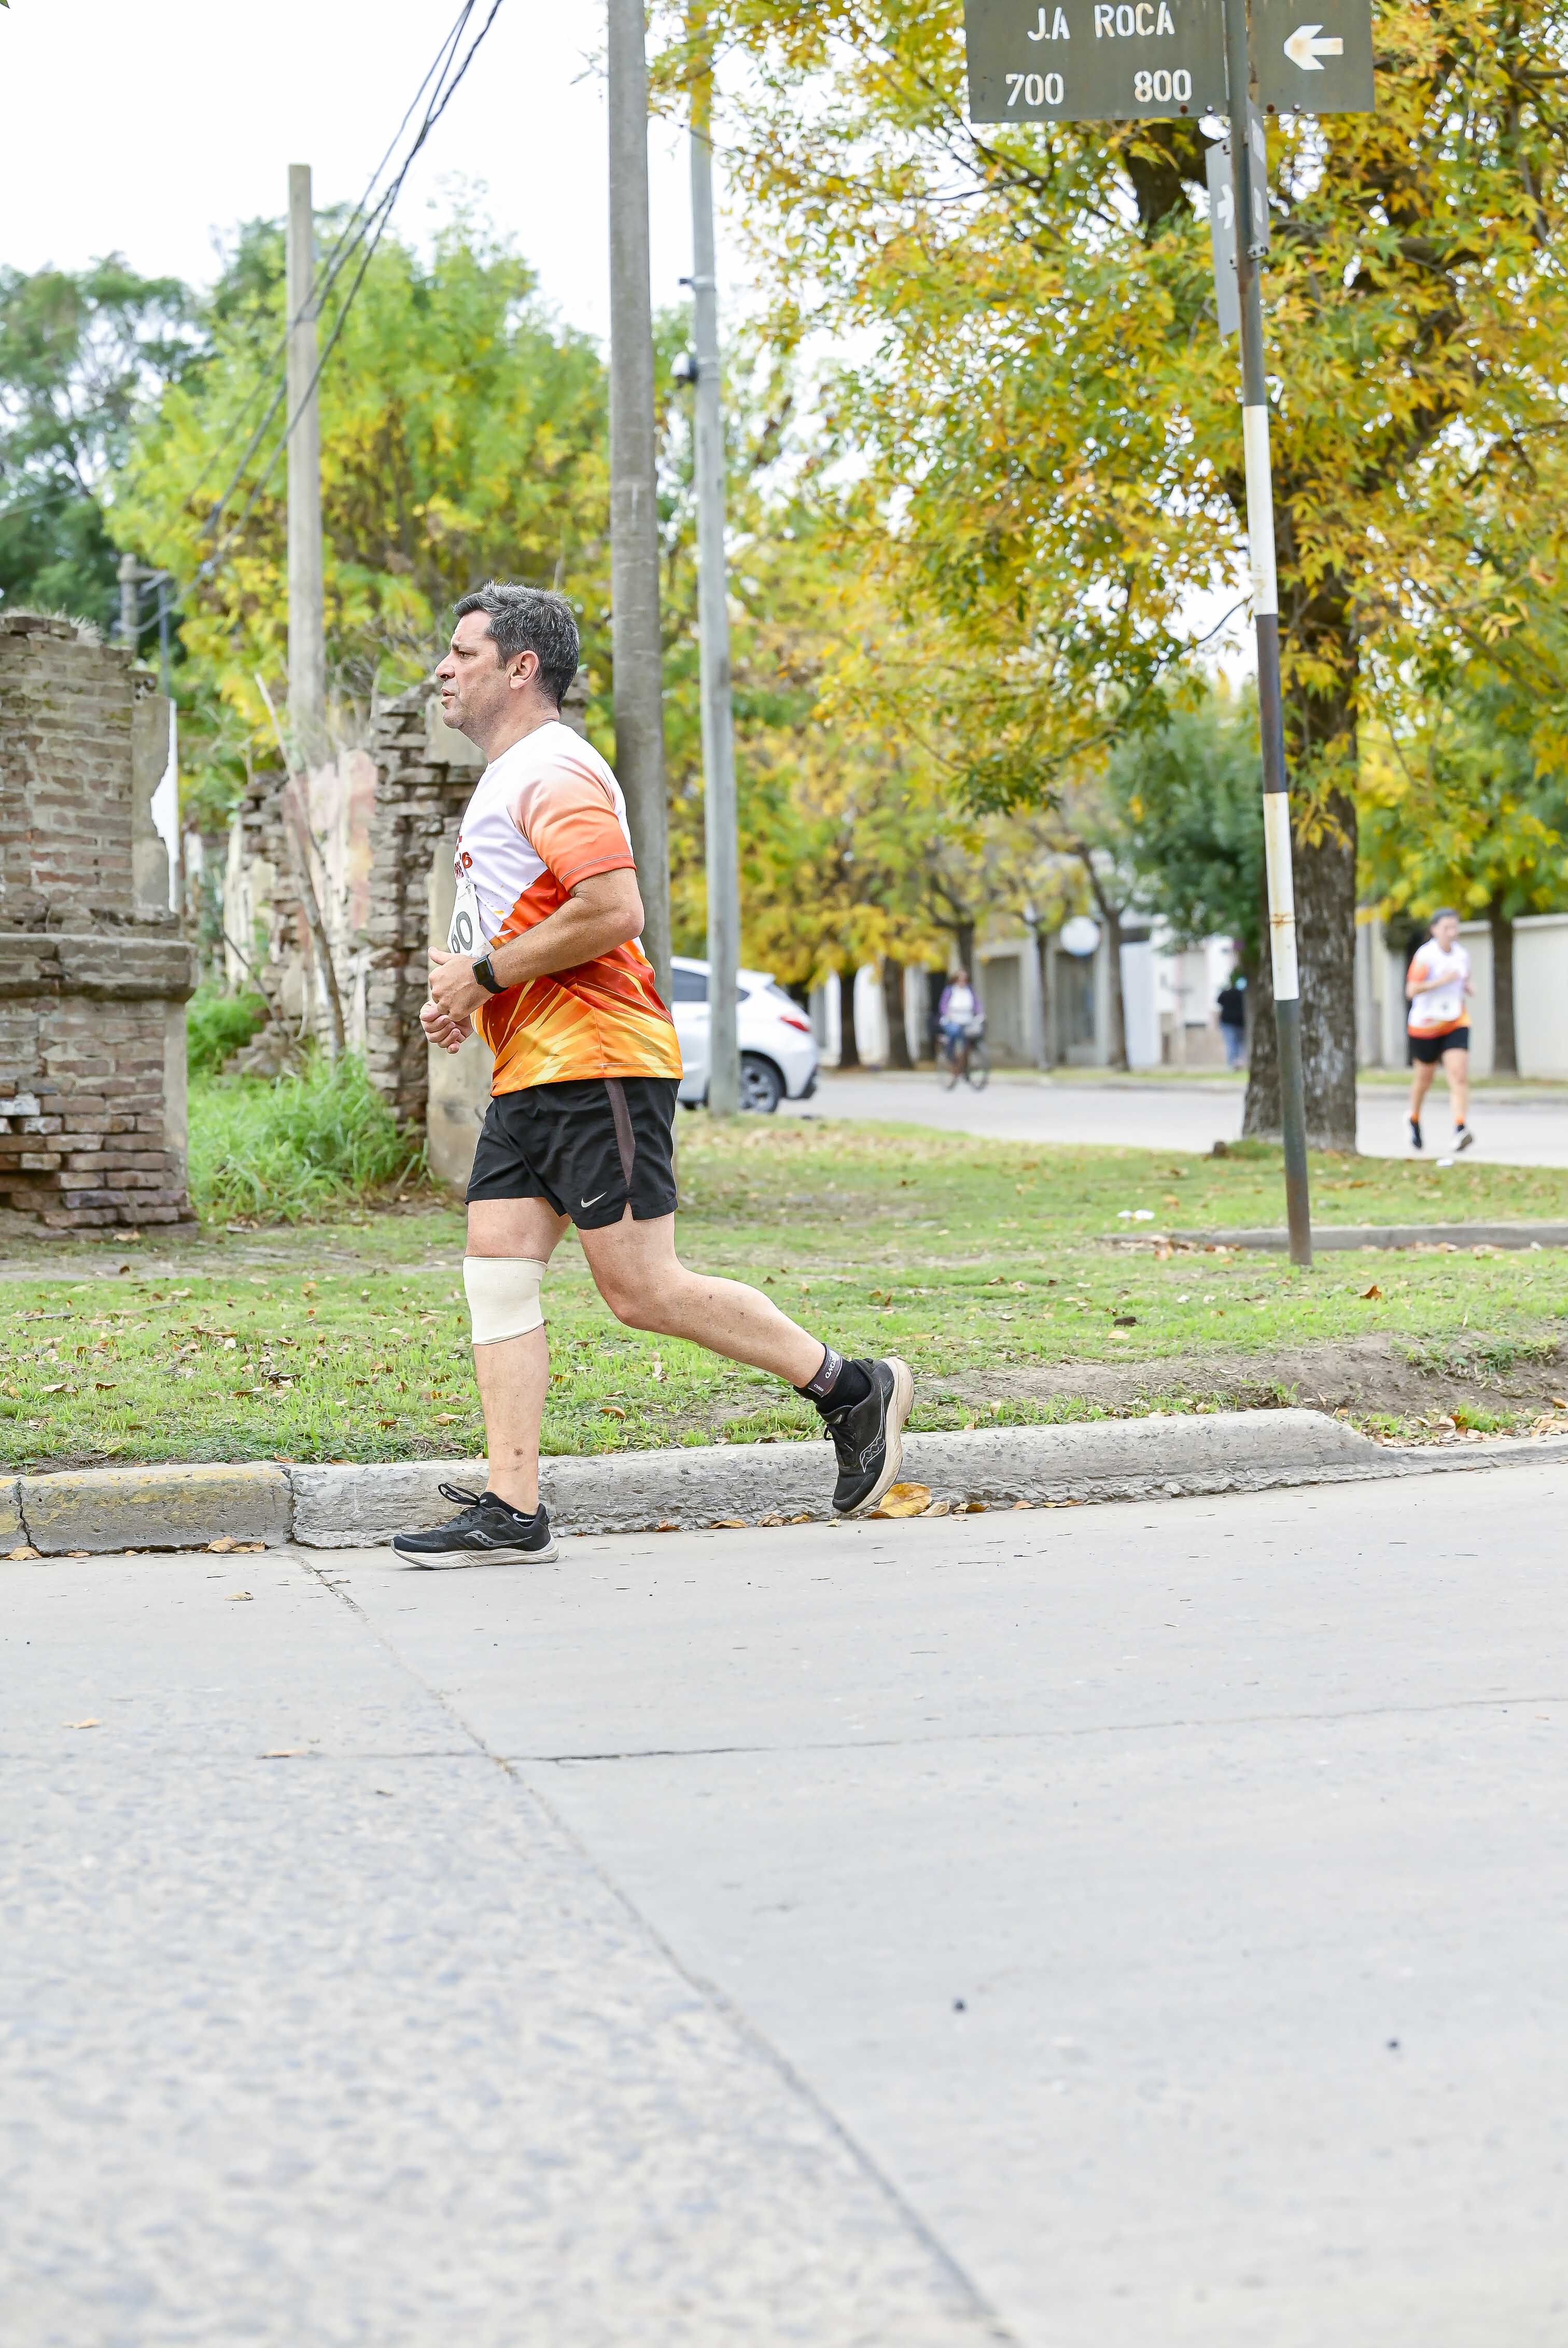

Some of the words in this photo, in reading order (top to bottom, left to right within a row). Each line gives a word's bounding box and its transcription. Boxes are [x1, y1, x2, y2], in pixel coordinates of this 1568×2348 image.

[1027, 7, 1070, 41] J.A
[1094, 1, 1175, 38] ROCA
[1005, 73, 1064, 106] 700
[1134, 69, 1192, 102] 800
